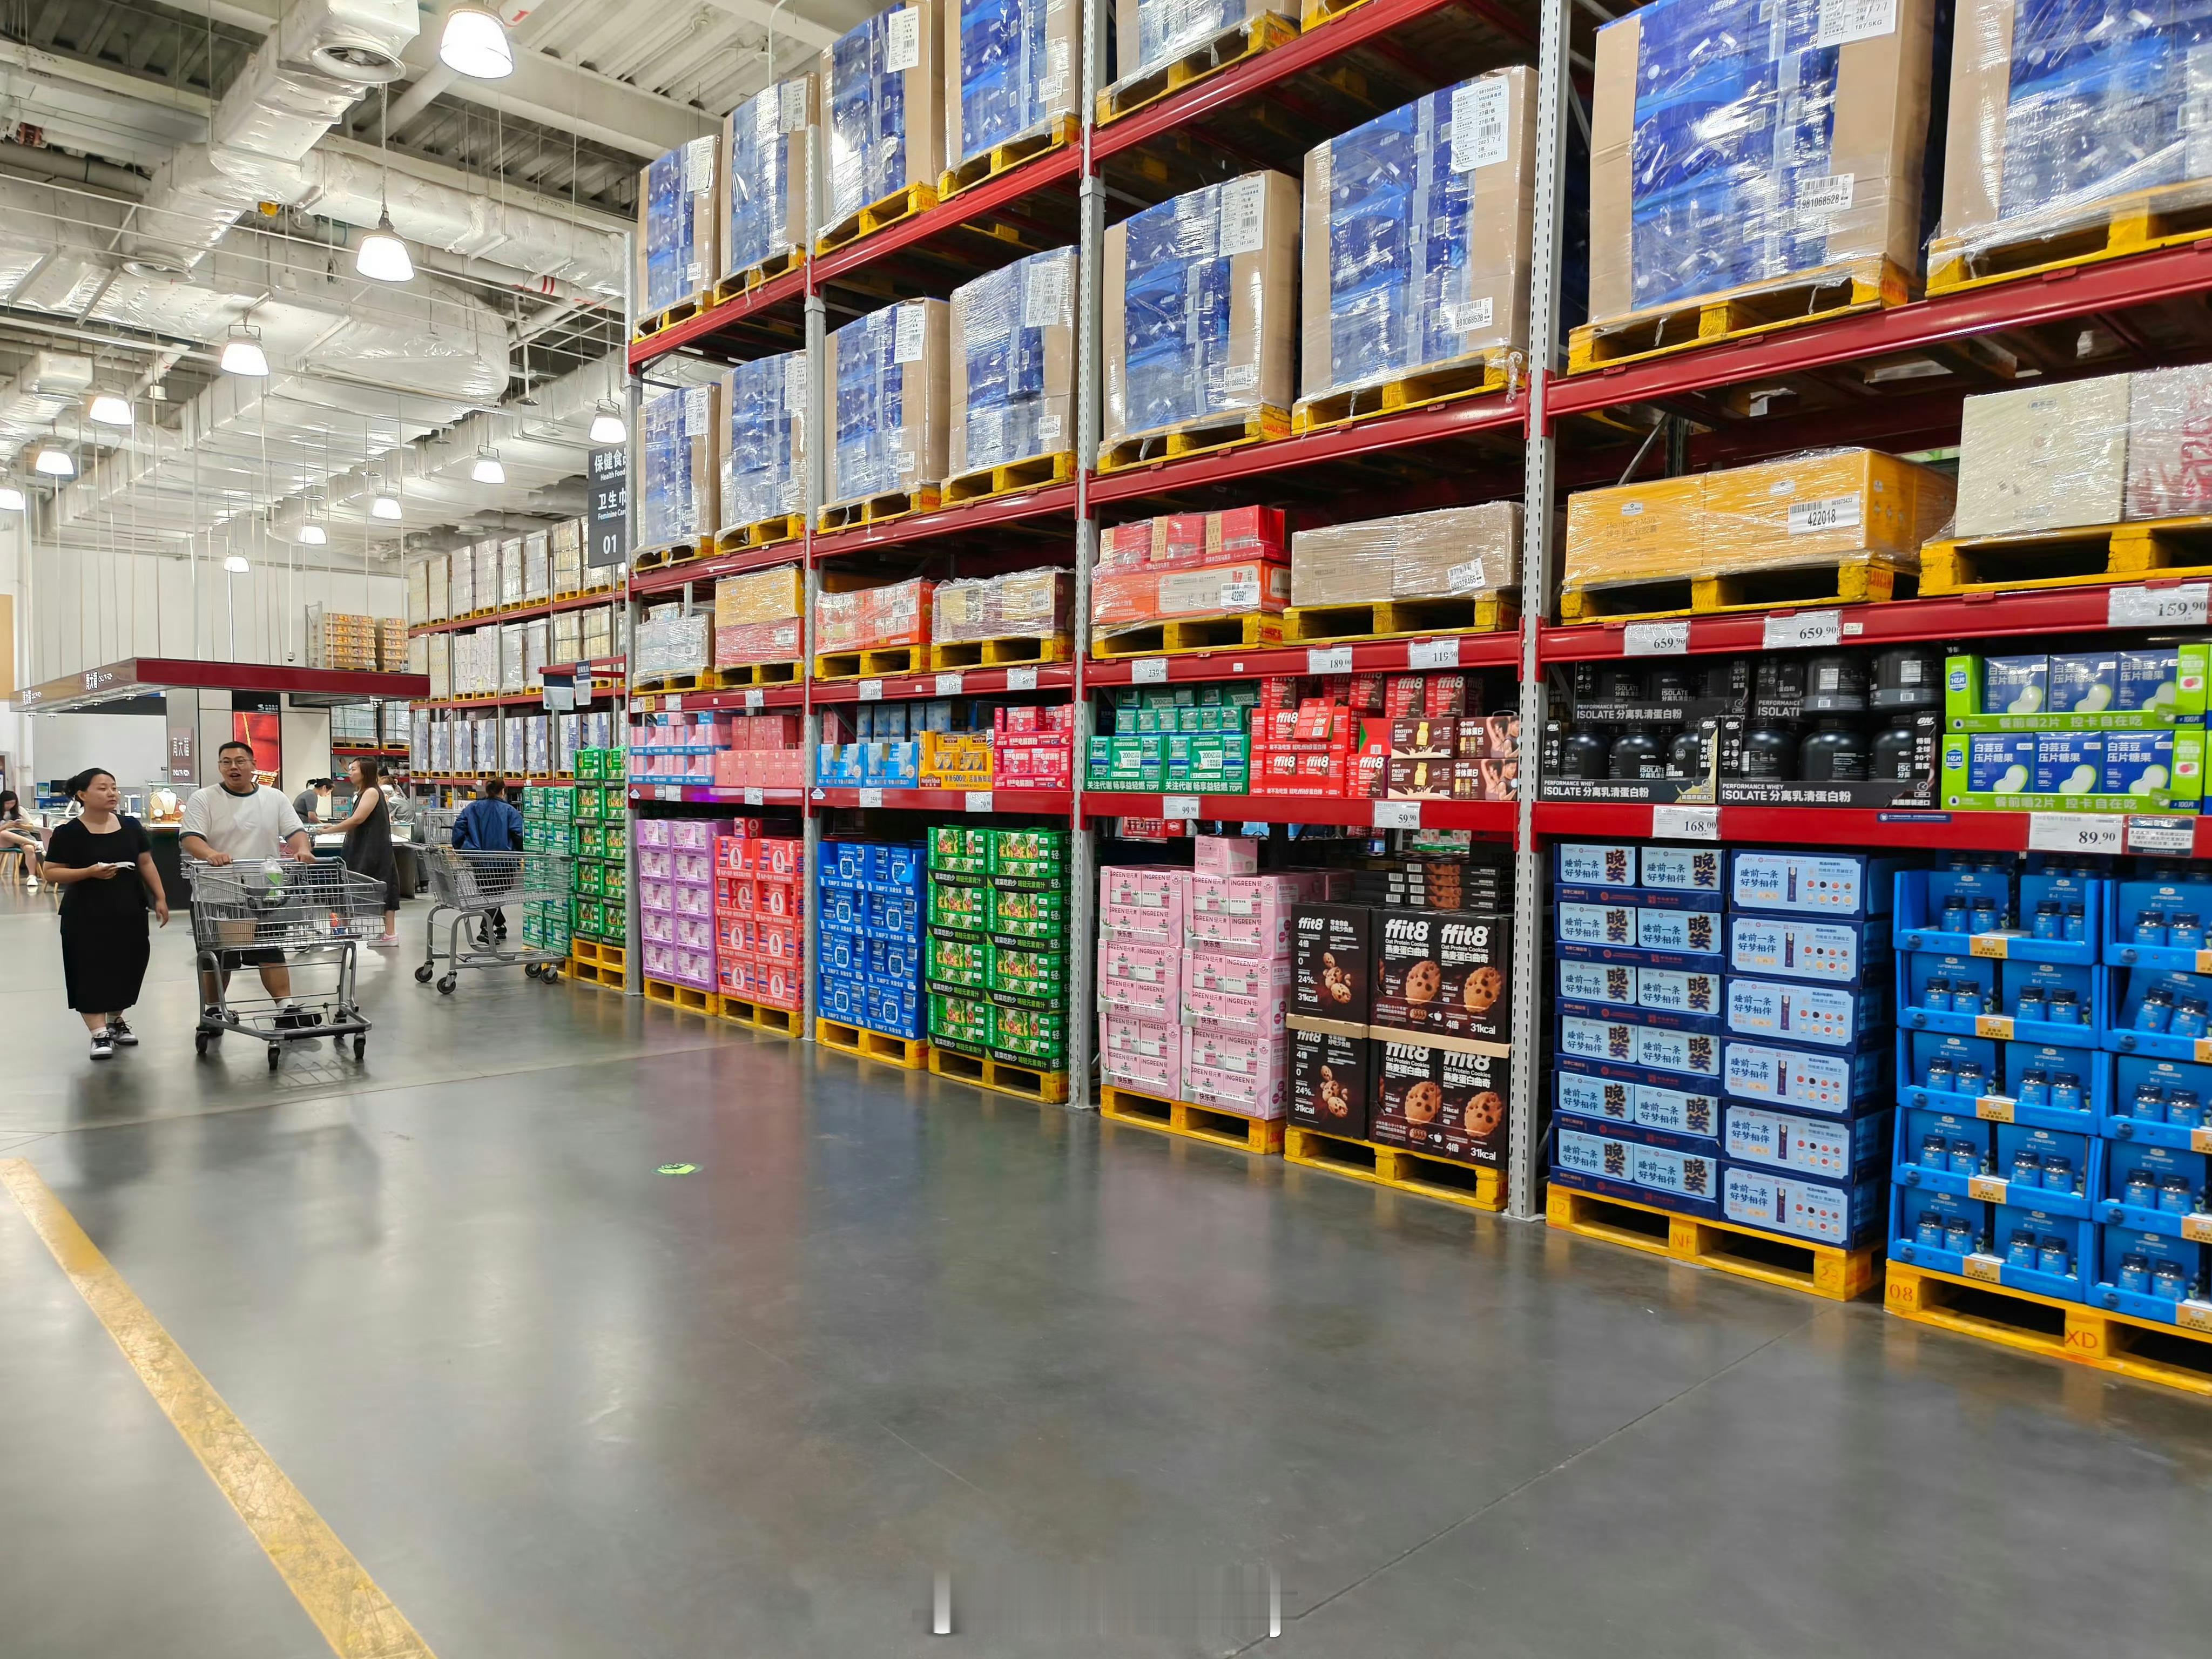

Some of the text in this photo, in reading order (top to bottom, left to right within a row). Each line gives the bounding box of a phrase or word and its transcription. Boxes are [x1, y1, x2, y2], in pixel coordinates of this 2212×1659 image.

[1802, 194, 1839, 208] 981068528
[1456, 314, 1483, 328] 981068528
[601, 471, 614, 481] Health
[598, 510, 617, 521] Feminine
[1808, 509, 1837, 527] 422018
[603, 534, 617, 555] 01
[1800, 625, 1837, 639] 659.90
[1654, 637, 1685, 649] 659.90
[1577, 709, 1682, 720] ISOLATE 分离乳清蛋白粉
[1974, 743, 2004, 752] 白芸豆
[2039, 742, 2070, 752] 白芸豆
[2108, 742, 2140, 752] 白芸豆
[1274, 756, 1295, 767] ffit8
[1306, 756, 1328, 767] ffit8
[1359, 757, 1384, 768] ffit8
[1974, 753, 2013, 763] 压片糖果
[2038, 752, 2080, 763] 压片糖果
[2107, 752, 2152, 763] 压片糖果
[1544, 787, 1649, 798] ISOLATE 分离乳清蛋白粉
[1722, 791, 1851, 803] ISOLATE 分离乳清蛋白粉
[1398, 814, 1417, 824] 59.90
[1684, 820, 1716, 833] 168.00
[2078, 831, 2115, 845] 89.90
[1741, 868, 1779, 879] 睡前一条
[1741, 878, 1779, 888] 好梦相伴
[1298, 917, 1323, 930] ffit8
[1385, 919, 1429, 941] ffit8
[1441, 923, 1488, 946] ffit8
[1738, 933, 1776, 943] 睡前一条
[1385, 945, 1429, 957] 燕麦蛋白曲奇
[1737, 942, 1776, 954] 好梦相伴
[1441, 950, 1488, 963] 燕麦蛋白曲奇
[1298, 975, 1314, 984] 24%
[1606, 967, 1629, 1001] 晚安
[1298, 993, 1318, 1002] 31kcal
[1734, 994, 1772, 1006] 睡前一条
[1734, 1004, 1772, 1015] 好梦相伴
[1446, 1020, 1496, 1034] 4倍 31kcal
[1608, 1026, 1630, 1060] 晚安
[1297, 1051, 1307, 1059] 4倍
[1688, 1036, 1712, 1072] 晚安
[1386, 1062, 1429, 1078] 燕麦蛋白曲奇
[1411, 1060, 1430, 1068] Cookies
[1731, 1058, 1769, 1070] 睡前一条
[1471, 1069, 1491, 1078] Cookies
[1731, 1068, 1769, 1080] 好梦相伴
[1444, 1072, 1491, 1088] 燕麦蛋白曲奇
[1295, 1104, 1314, 1115] 31kcal
[1687, 1097, 1710, 1133] 晚安
[1731, 1120, 1770, 1134] 睡前一条
[1731, 1130, 1770, 1143] 好梦相伴
[1446, 1142, 1496, 1161] 4倍 31kcal
[1603, 1143, 1626, 1177] 晚安
[1638, 1170, 1676, 1185] 好梦相伴
[1683, 1159, 1708, 1195] 晚安
[1730, 1183, 1768, 1197] 睡前一条
[1730, 1192, 1768, 1206] 好梦相伴
[1890, 1283, 1913, 1303] 08
[2065, 1330, 2098, 1349] XD
